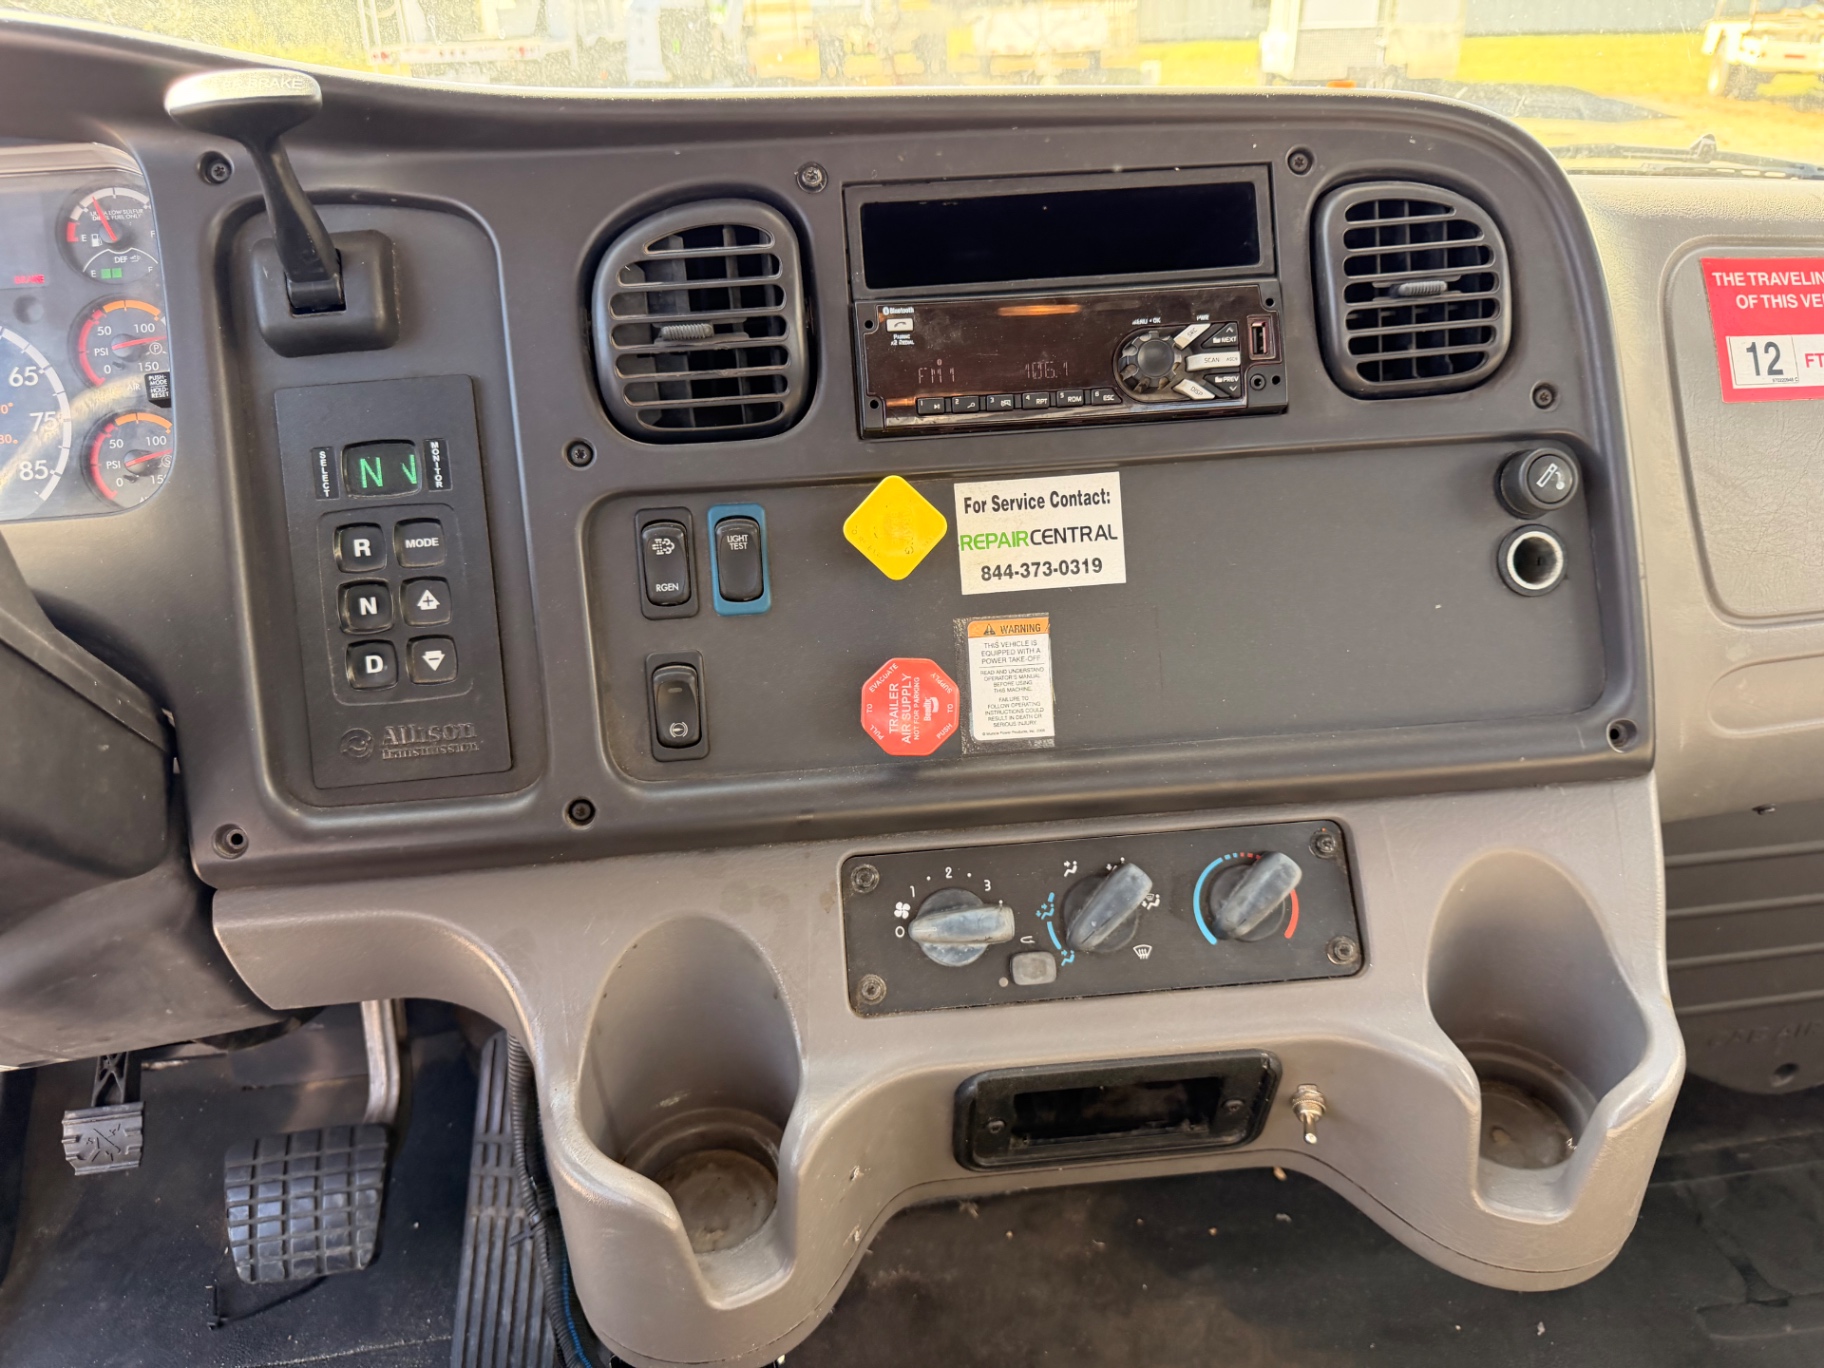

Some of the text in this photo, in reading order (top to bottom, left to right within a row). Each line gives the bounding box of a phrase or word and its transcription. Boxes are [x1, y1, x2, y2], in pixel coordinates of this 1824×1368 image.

[81, 234, 87, 242] E
[150, 230, 156, 239] F
[114, 255, 128, 264] DEF
[90, 269, 97, 278] E
[1712, 272, 1746, 287] THE
[1736, 293, 1824, 309] OF THIS VE
[97, 326, 112, 336] 50
[134, 323, 156, 333] 100
[94, 347, 109, 356] PSI
[1746, 341, 1784, 376] 12
[1805, 353, 1824, 368] FT
[103, 364, 112, 374] 0
[138, 361, 159, 372] 150
[8, 366, 39, 388] 65
[127, 383, 141, 391] AIR
[30, 411, 57, 432] 75
[109, 439, 124, 449] 50
[145, 435, 167, 446] 100
[19, 460, 49, 481] 85
[106, 461, 121, 470] PSI
[430, 441, 444, 488] MONITOR
[150, 473, 167, 485] 15
[319, 451, 330, 498] SELECT
[360, 457, 383, 489] N
[115, 477, 124, 487] 0
[964, 488, 1111, 514] For Service Contact:
[405, 537, 440, 549] MODE
[727, 535, 748, 543] LIGHT
[353, 537, 372, 558] R
[730, 542, 748, 550] TEST
[980, 557, 1103, 581] 844-373-0319
[655, 583, 679, 592] RGEN
[359, 596, 378, 615] N
[1000, 624, 1041, 634] WARNING
[984, 641, 1000, 649] THIS
[1001, 640, 1029, 648] VEHICLE
[981, 649, 1015, 657] EQUIPPED
[1017, 648, 1035, 656] WITH
[365, 656, 384, 674] D
[982, 655, 1041, 665] POWER TAKE-OFF
[869, 662, 899, 693] EVACUATE
[930, 672, 953, 694] SUPPLY
[866, 703, 873, 714] TO
[889, 683, 900, 734] TRAILER
[901, 673, 912, 744] AIR SUPPLY
[947, 703, 954, 714] TO
[382, 722, 477, 745] Allison
[870, 724, 885, 740] PULL
[936, 723, 953, 739] PUSH
[945, 866, 953, 879] 2
[984, 879, 991, 891] 3
[909, 885, 915, 898] 1
